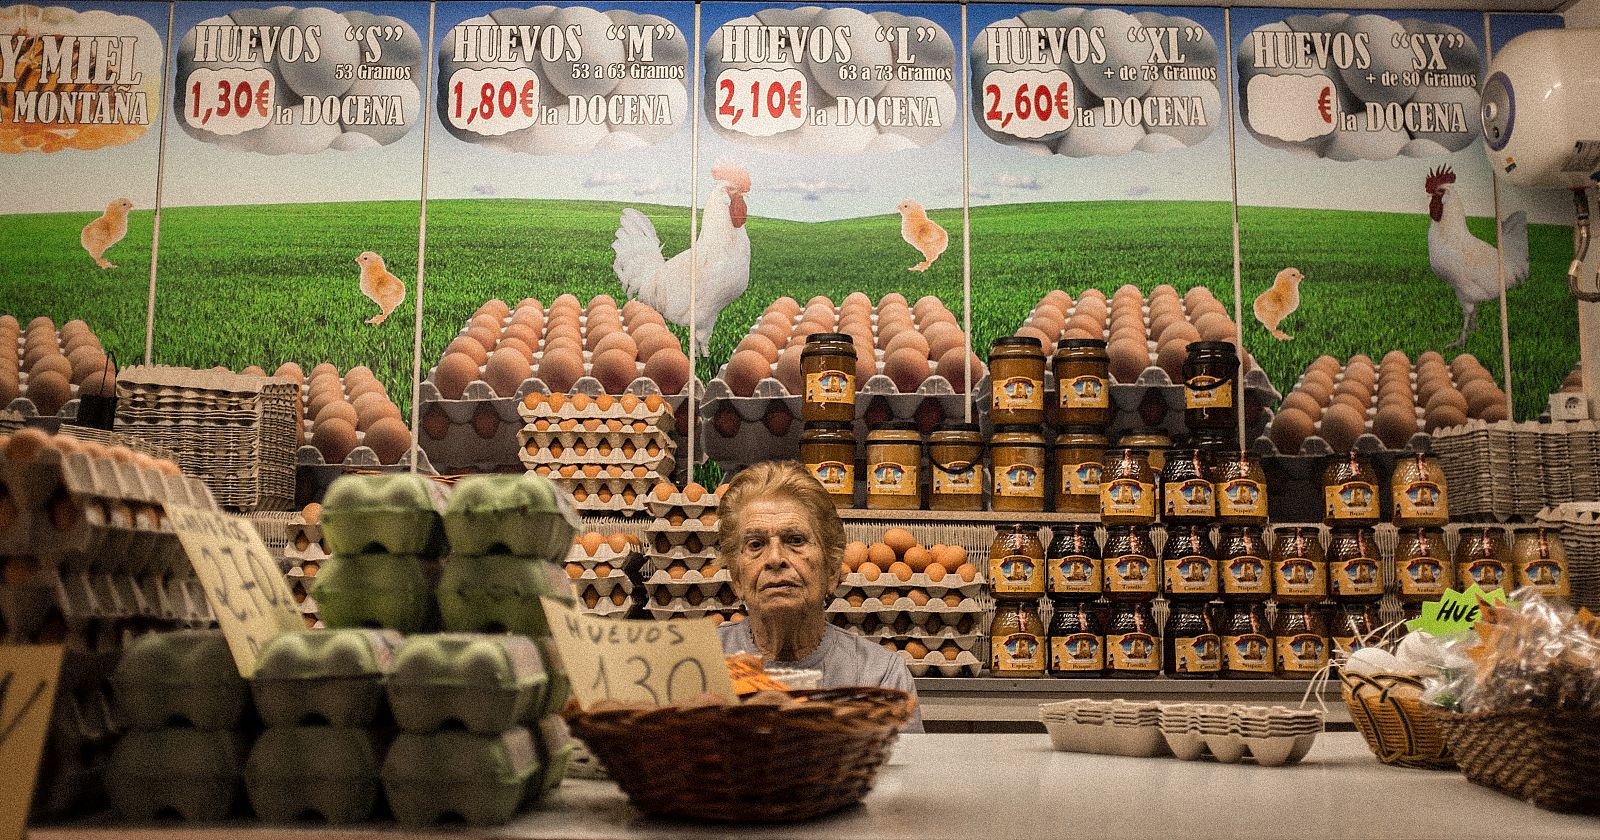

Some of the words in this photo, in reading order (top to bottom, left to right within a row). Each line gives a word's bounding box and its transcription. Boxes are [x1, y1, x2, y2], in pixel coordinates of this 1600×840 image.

[38, 34, 143, 86] MIEL
[192, 24, 321, 63] HUEVOS
[452, 24, 582, 63] HUEVOS
[720, 25, 852, 64] HUEVOS
[985, 26, 1108, 65] HUEVOS
[1252, 31, 1371, 70] HUEVOS
[334, 64, 353, 80] 53
[357, 64, 412, 80] Gramos
[571, 63, 590, 79] 53
[594, 67, 603, 79] a
[607, 63, 626, 79] 63
[630, 63, 685, 80] Gramos
[838, 65, 858, 80] 63
[861, 68, 871, 80] a
[875, 65, 893, 81] 73
[897, 65, 952, 81] Gramos
[1103, 67, 1115, 79] +
[1119, 65, 1138, 81] de
[1140, 65, 1159, 81] 73
[1163, 65, 1217, 81] Gramos
[1365, 72, 1377, 84] +
[1381, 70, 1399, 87] de
[1402, 71, 1420, 87] 80
[1424, 71, 1477, 87] Gramos
[12, 84, 149, 125] MONTAÑA
[192, 80, 270, 125] 1,30€
[275, 105, 293, 125] la
[301, 95, 405, 126] DOCENA
[454, 80, 534, 125] 1,80€
[540, 105, 559, 125] la
[567, 94, 673, 126] DOCENA
[719, 79, 802, 125] 2,10€
[809, 106, 827, 126] la
[835, 96, 942, 127] DOCENA
[986, 82, 1068, 128] 2,60€
[1077, 106, 1095, 128] la
[1103, 96, 1208, 128] DOCENA
[1317, 86, 1332, 124] €
[1339, 111, 1358, 132] la
[1365, 101, 1469, 133] DOCENA
